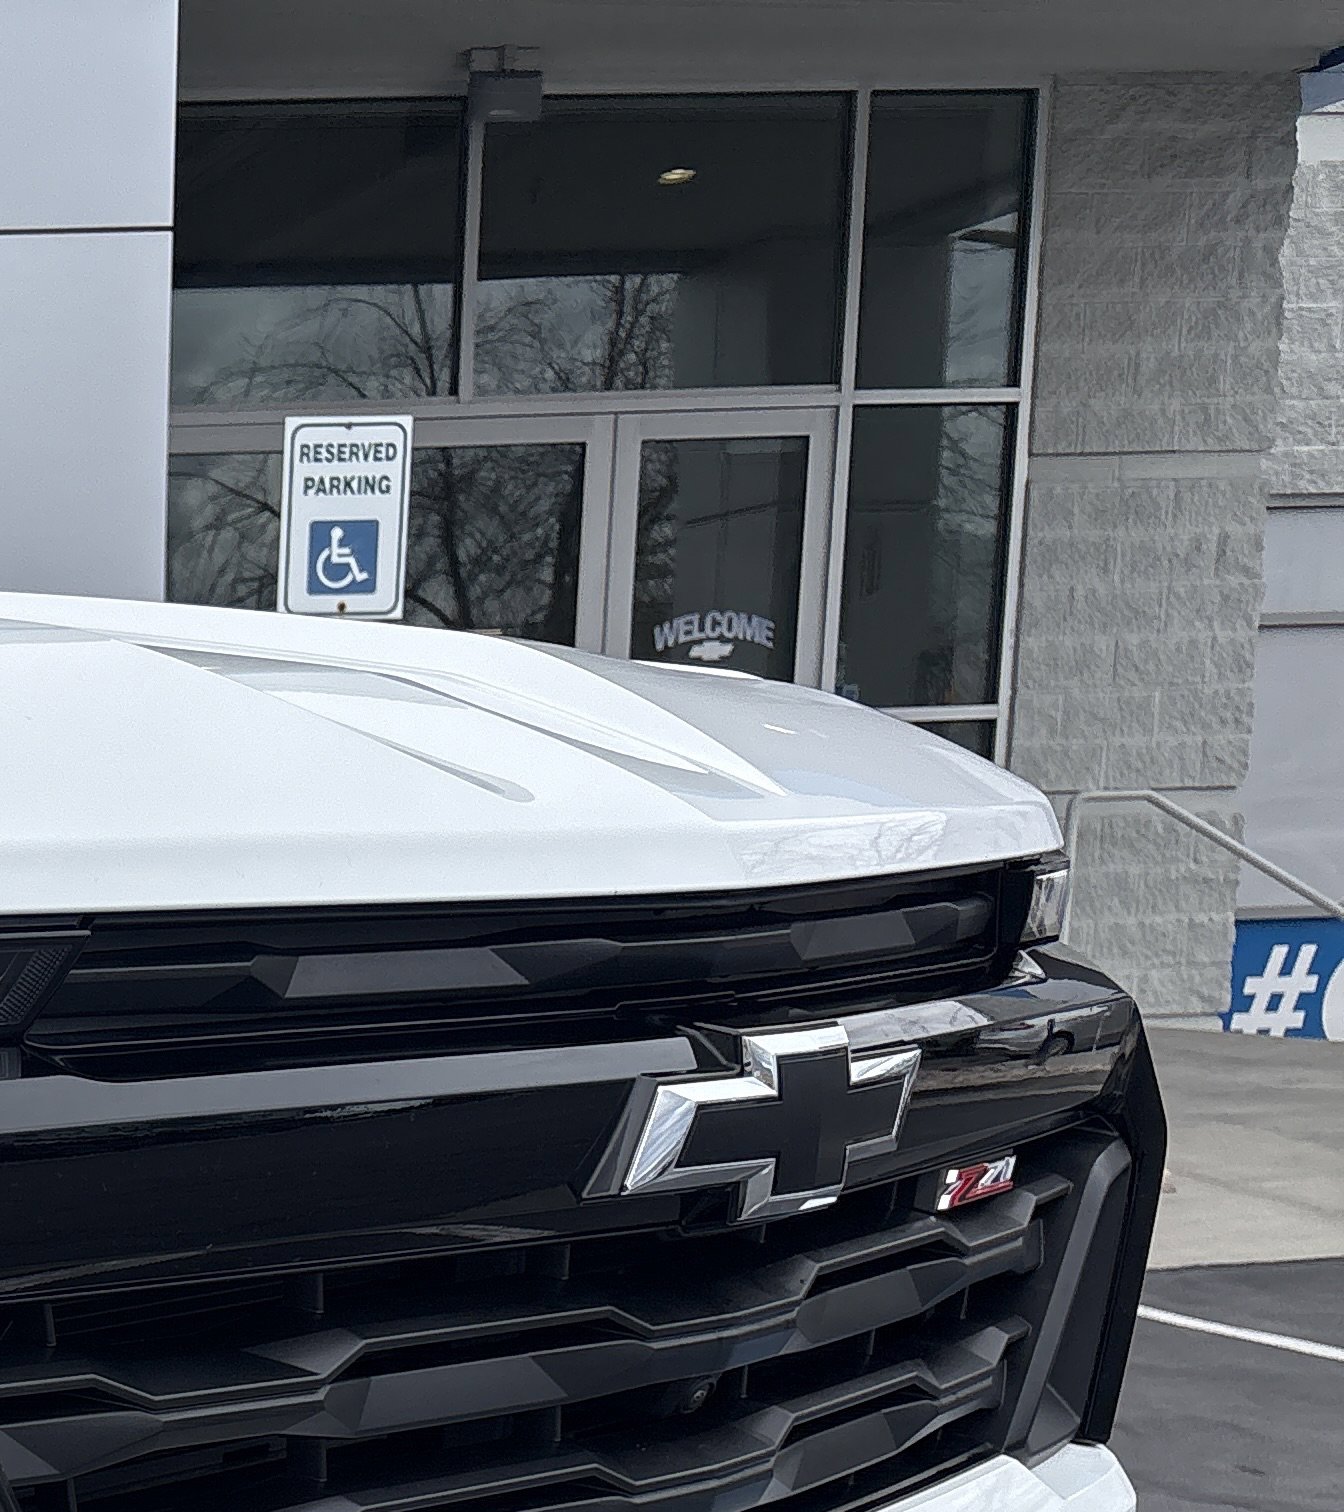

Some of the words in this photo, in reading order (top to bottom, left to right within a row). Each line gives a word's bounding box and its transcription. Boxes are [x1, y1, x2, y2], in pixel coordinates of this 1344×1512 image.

[298, 441, 399, 465] RESERVED
[302, 474, 393, 497] PARKING
[652, 609, 777, 653] WELCOME
